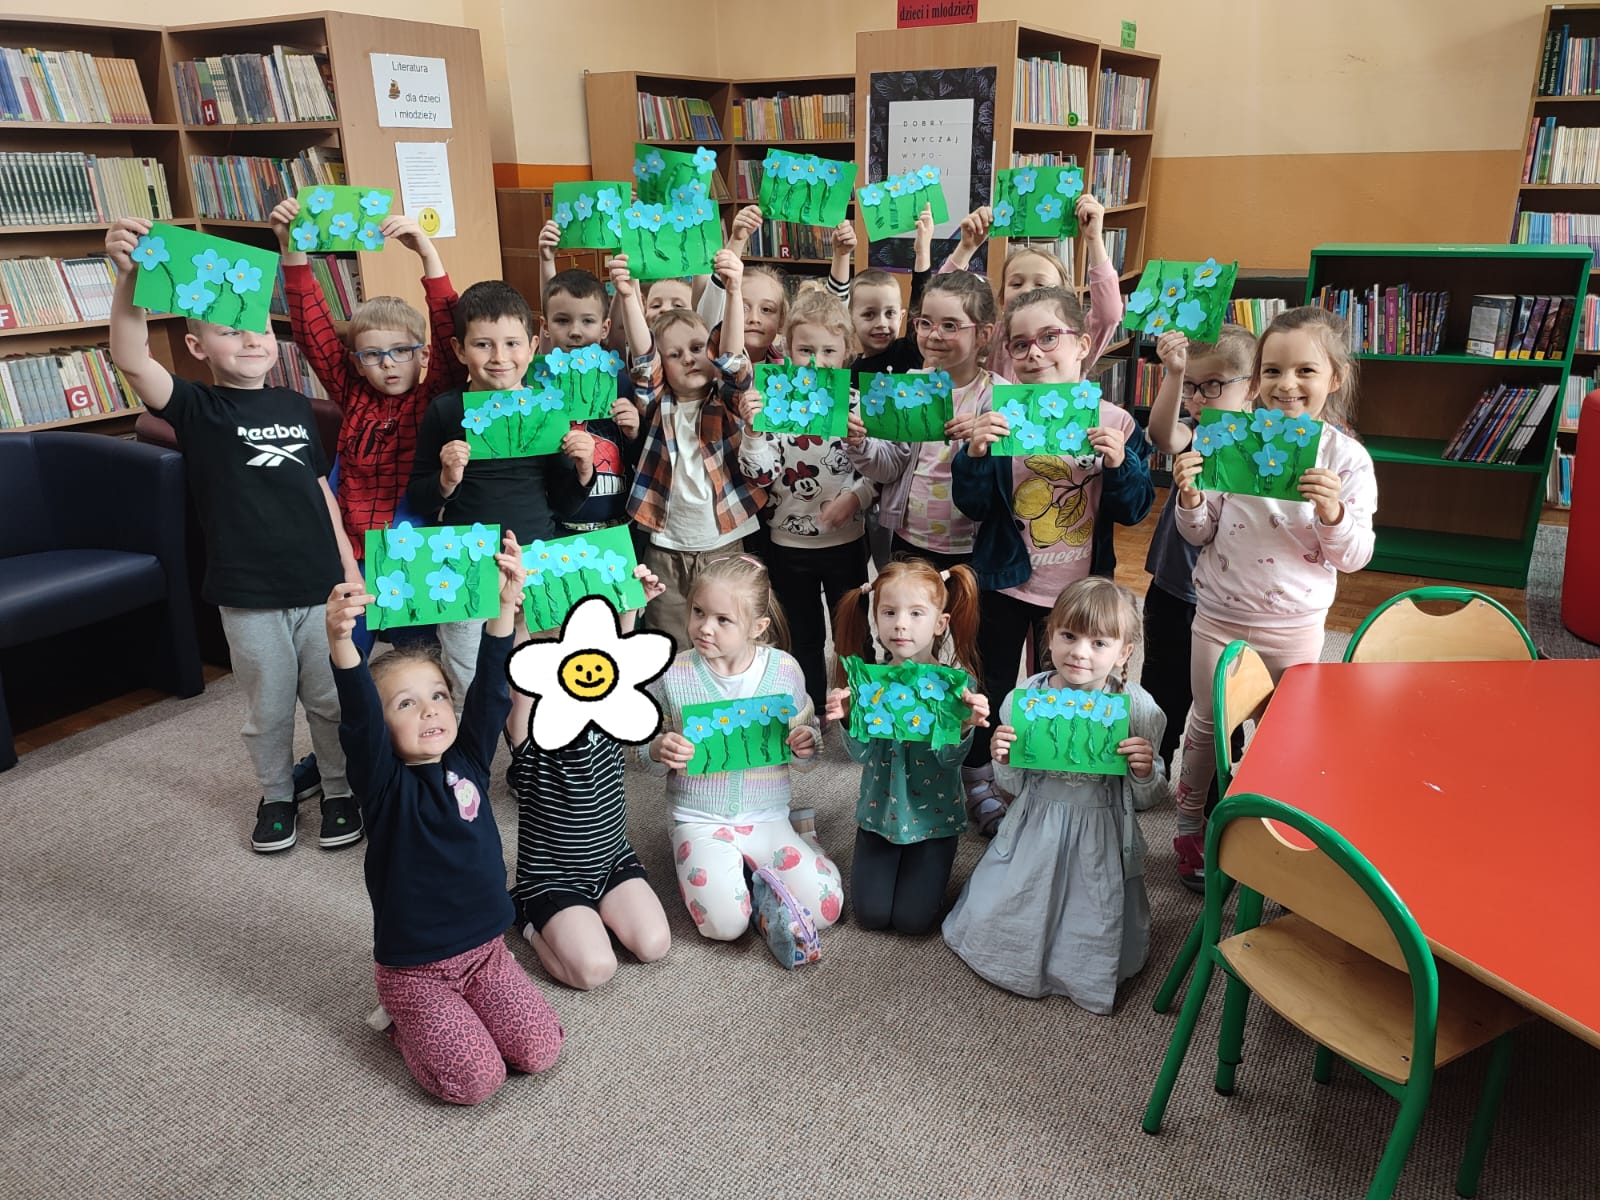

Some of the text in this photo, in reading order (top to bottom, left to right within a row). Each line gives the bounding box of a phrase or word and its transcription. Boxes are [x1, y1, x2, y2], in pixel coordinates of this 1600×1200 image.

[900, 5, 924, 20] dzieci
[926, 5, 929, 19] i
[392, 61, 428, 73] Literatura
[405, 93, 441, 103] dla dzieci
[204, 103, 215, 122] H
[400, 110, 437, 121] młodzieży
[903, 136, 959, 144] ZWYCZAJ
[781, 247, 790, 257] R
[71, 390, 89, 407] G
[1026, 546, 1090, 570] queeze
